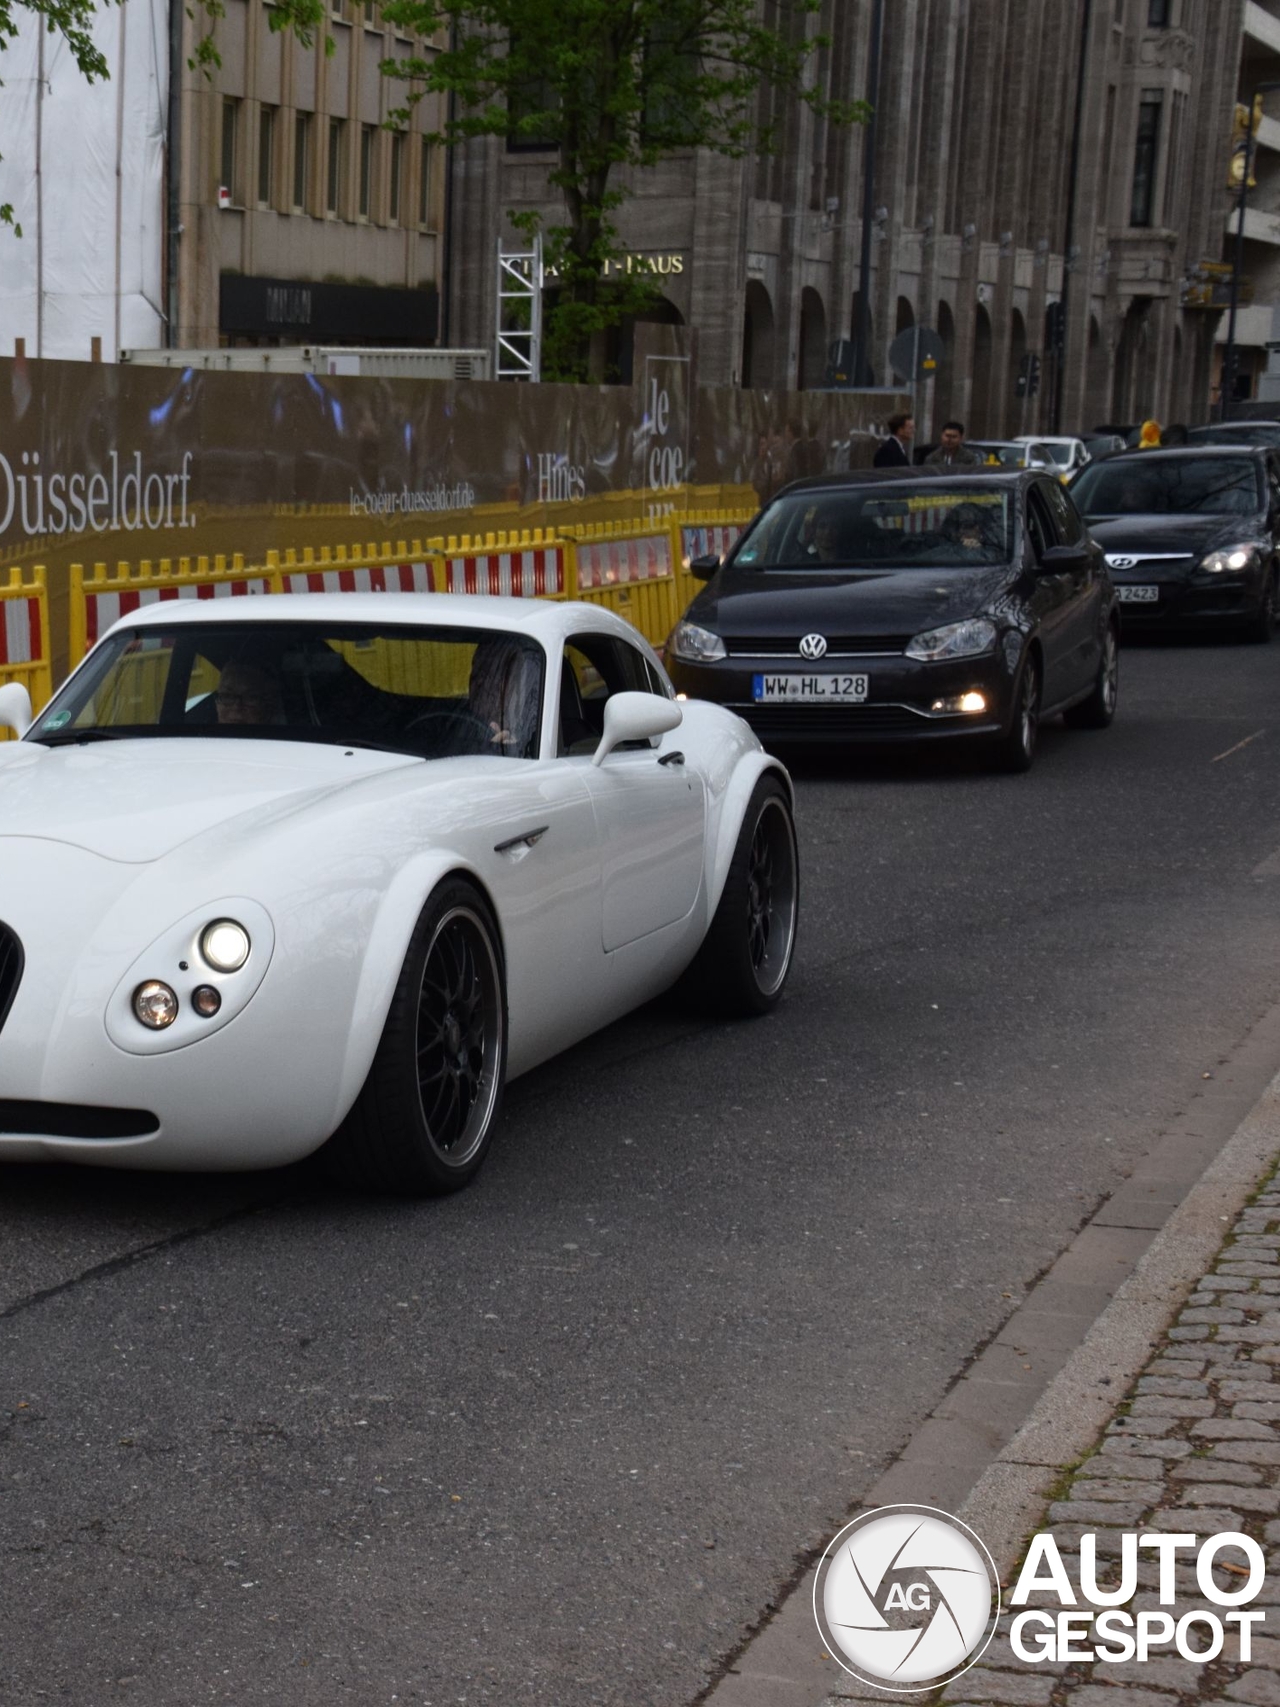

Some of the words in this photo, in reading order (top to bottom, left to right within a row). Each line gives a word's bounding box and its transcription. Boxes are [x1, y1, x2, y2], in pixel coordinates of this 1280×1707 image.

[651, 378, 669, 435] le
[537, 453, 586, 503] Hines
[649, 446, 683, 492] coe
[349, 482, 475, 516] le-coeur-duesseldorf.de
[765, 677, 789, 695] WW
[801, 677, 826, 695] HL
[830, 677, 866, 695] 128
